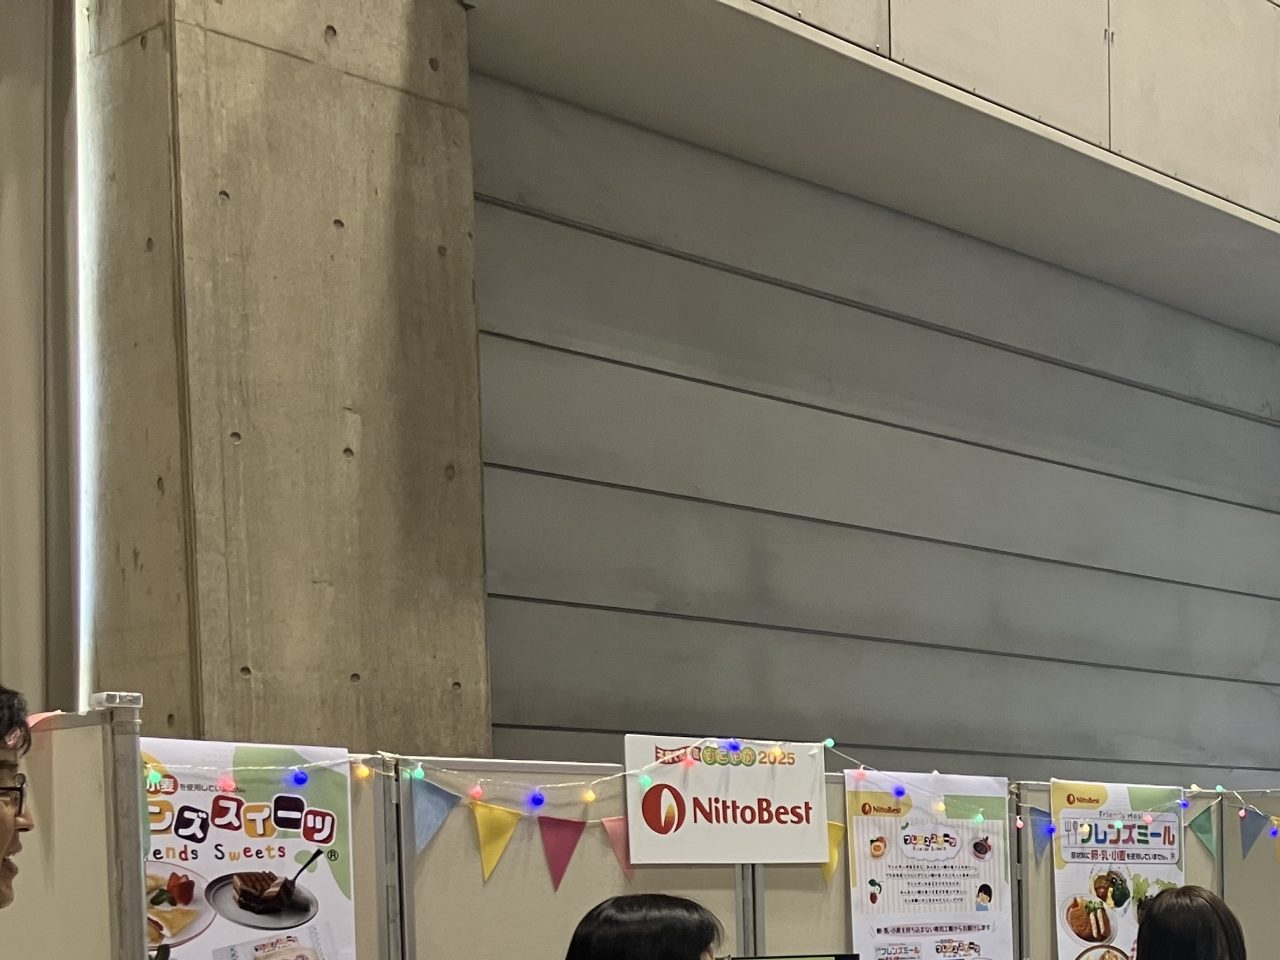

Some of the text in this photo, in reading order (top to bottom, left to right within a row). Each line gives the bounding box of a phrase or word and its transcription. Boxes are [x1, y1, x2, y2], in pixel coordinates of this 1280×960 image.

[758, 751, 795, 765] 2025
[693, 797, 812, 824] NittoBest
[1080, 823, 1175, 846] フレンズミール
[215, 844, 286, 861] Sweets
